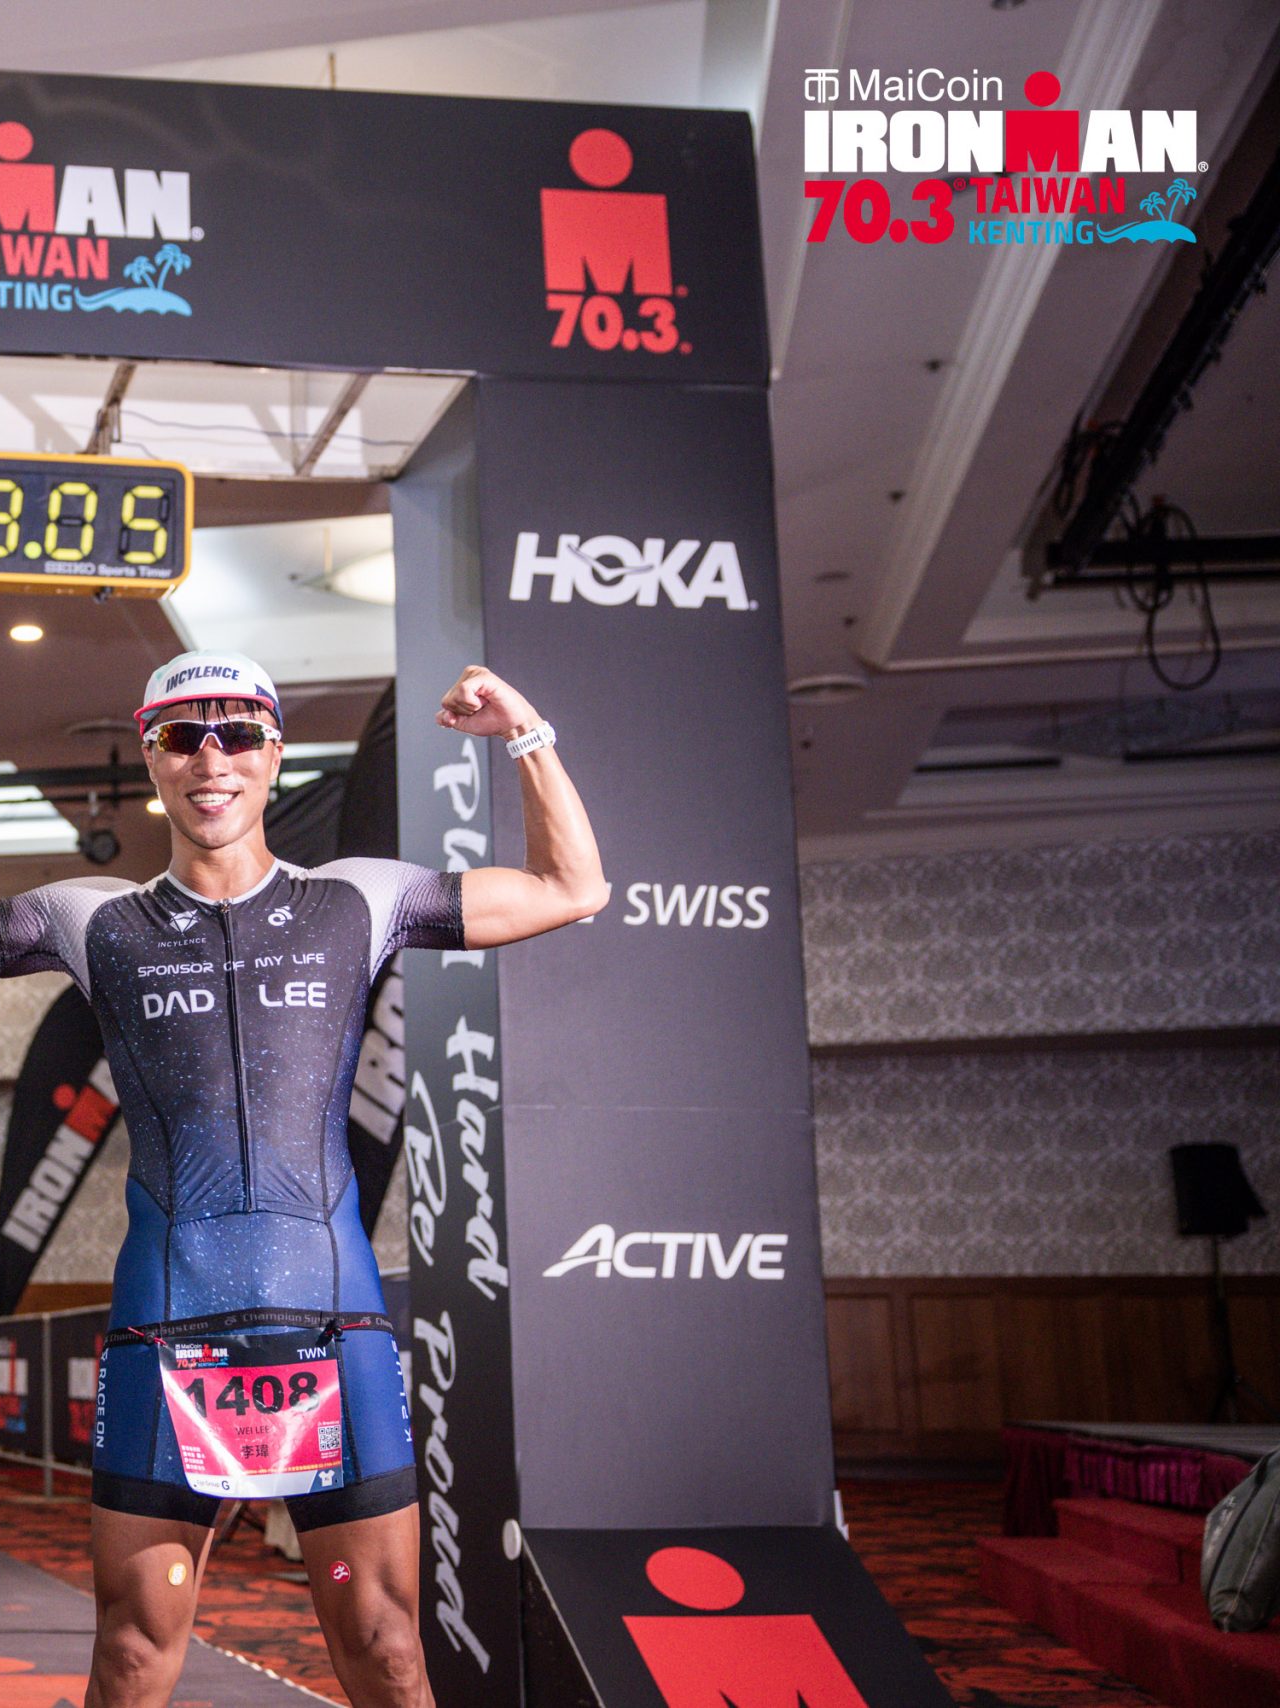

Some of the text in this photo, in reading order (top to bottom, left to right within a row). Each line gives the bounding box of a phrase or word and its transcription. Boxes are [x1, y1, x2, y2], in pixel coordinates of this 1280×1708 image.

[546, 296, 682, 355] 70.3
[509, 532, 749, 611] HOKA
[165, 665, 240, 693] INCYLENCE
[623, 883, 770, 929] SWISS
[157, 937, 207, 948] INCYLENCE
[137, 952, 325, 978] SPONSOR OF MY LIFE
[142, 981, 327, 1020] DAD LEE
[446, 1015, 509, 1301] Hard
[542, 1223, 789, 1280] ACTIVE
[243, 1312, 302, 1323] Champion
[175, 1343, 228, 1359] IRONMAN
[297, 1347, 327, 1360] TWN
[404, 1070, 489, 1674] Be Proud
[96, 1367, 108, 1448] RACE ON
[183, 1371, 320, 1418] 1408
[235, 1426, 270, 1435] WEI LEE
[221, 1480, 230, 1490] G
